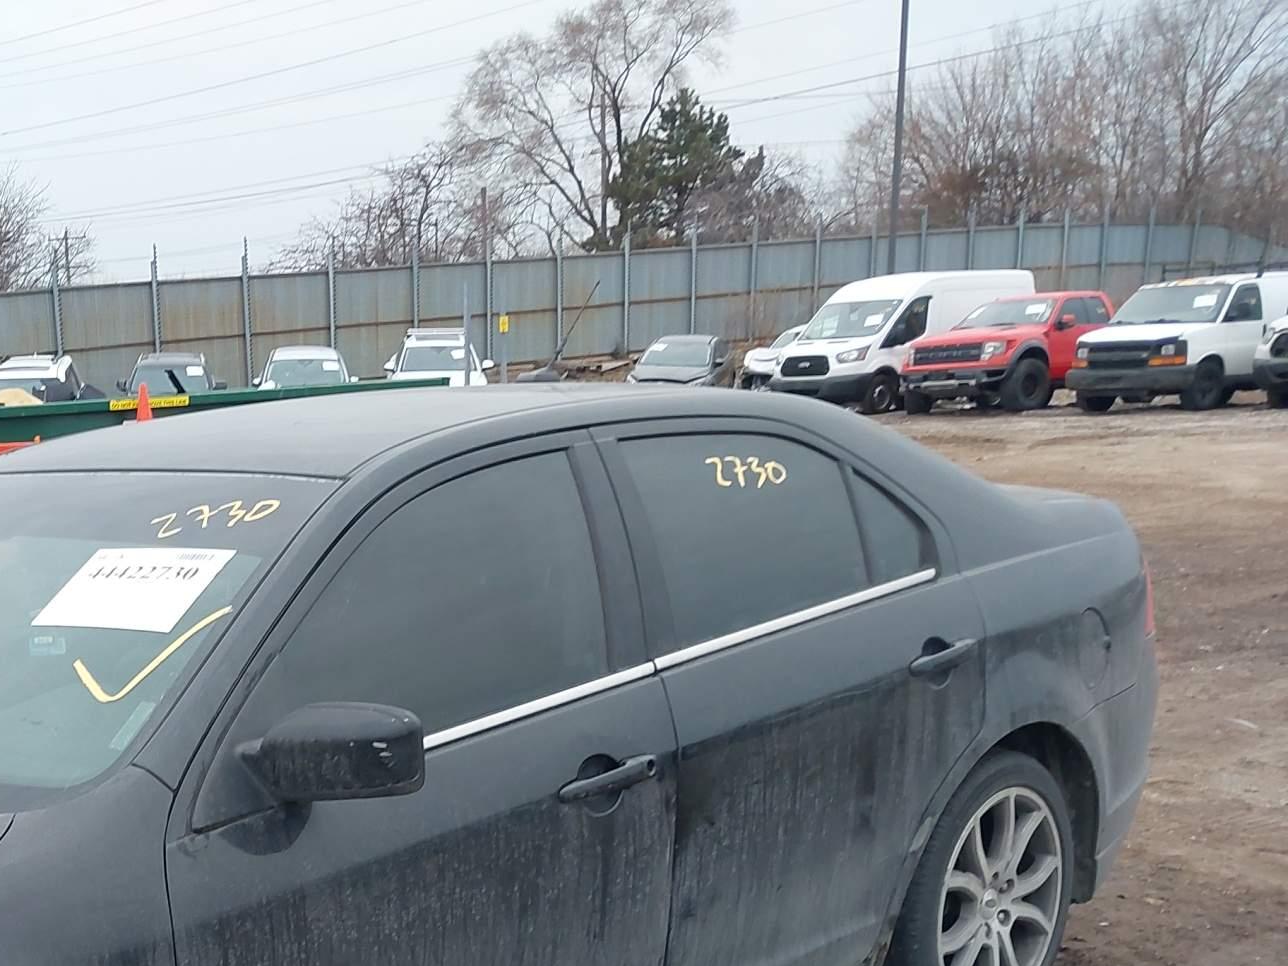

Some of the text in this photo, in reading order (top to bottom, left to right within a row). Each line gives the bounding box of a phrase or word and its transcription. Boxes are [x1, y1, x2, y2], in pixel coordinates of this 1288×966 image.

[704, 456, 787, 488] 2730
[150, 499, 281, 538] 2730
[87, 566, 200, 580] 44422730
